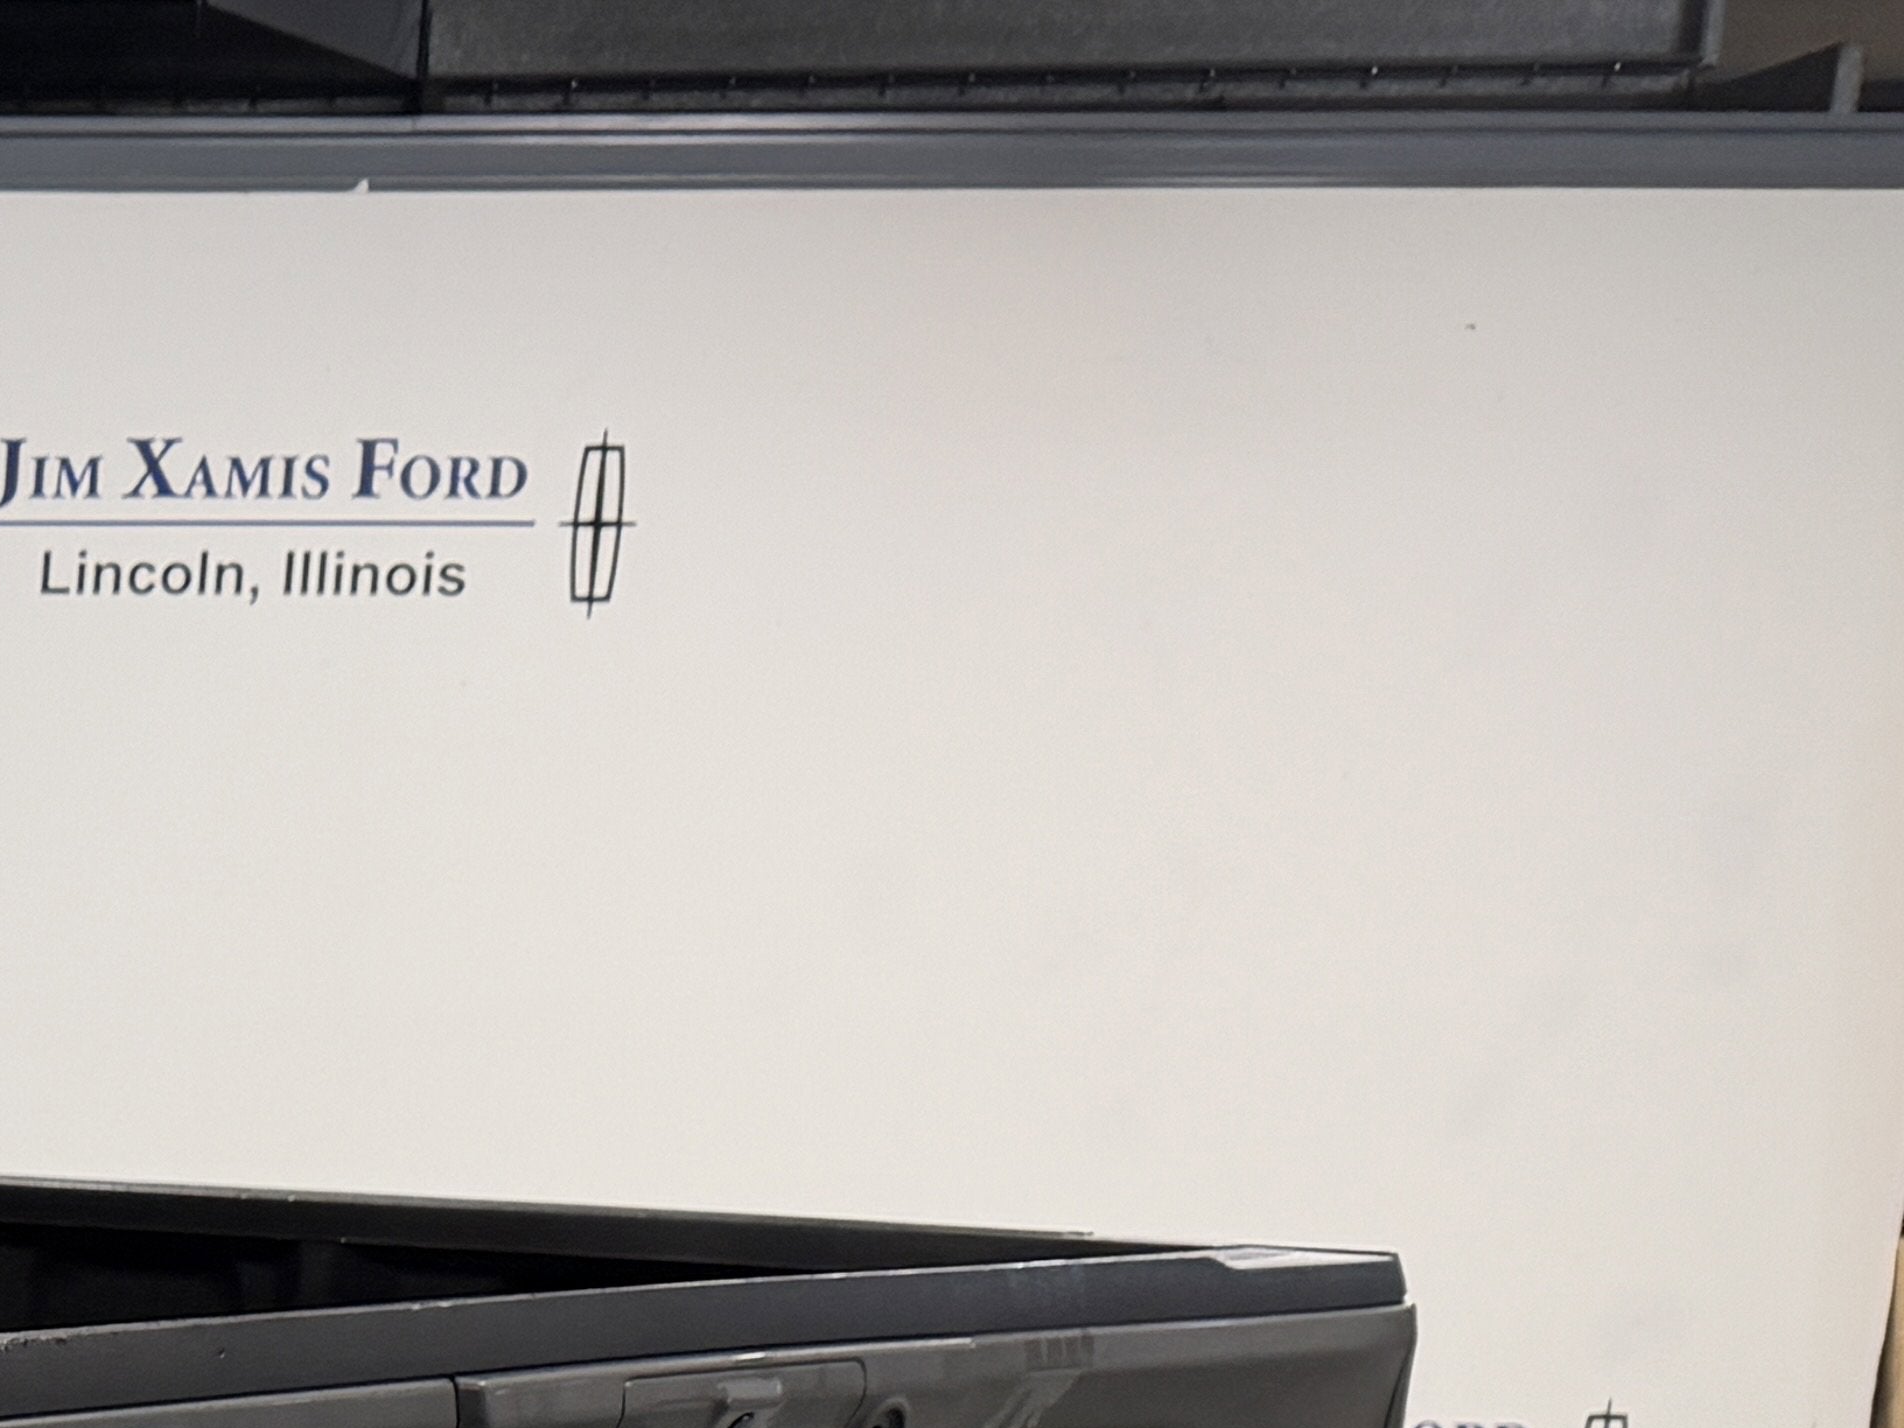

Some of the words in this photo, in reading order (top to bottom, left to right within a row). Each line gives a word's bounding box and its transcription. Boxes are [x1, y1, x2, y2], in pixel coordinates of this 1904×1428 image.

[127, 437, 331, 501] XAMIS
[351, 437, 529, 501] FORD
[40, 549, 260, 605] Lincoln,
[282, 549, 467, 598] Illinois
